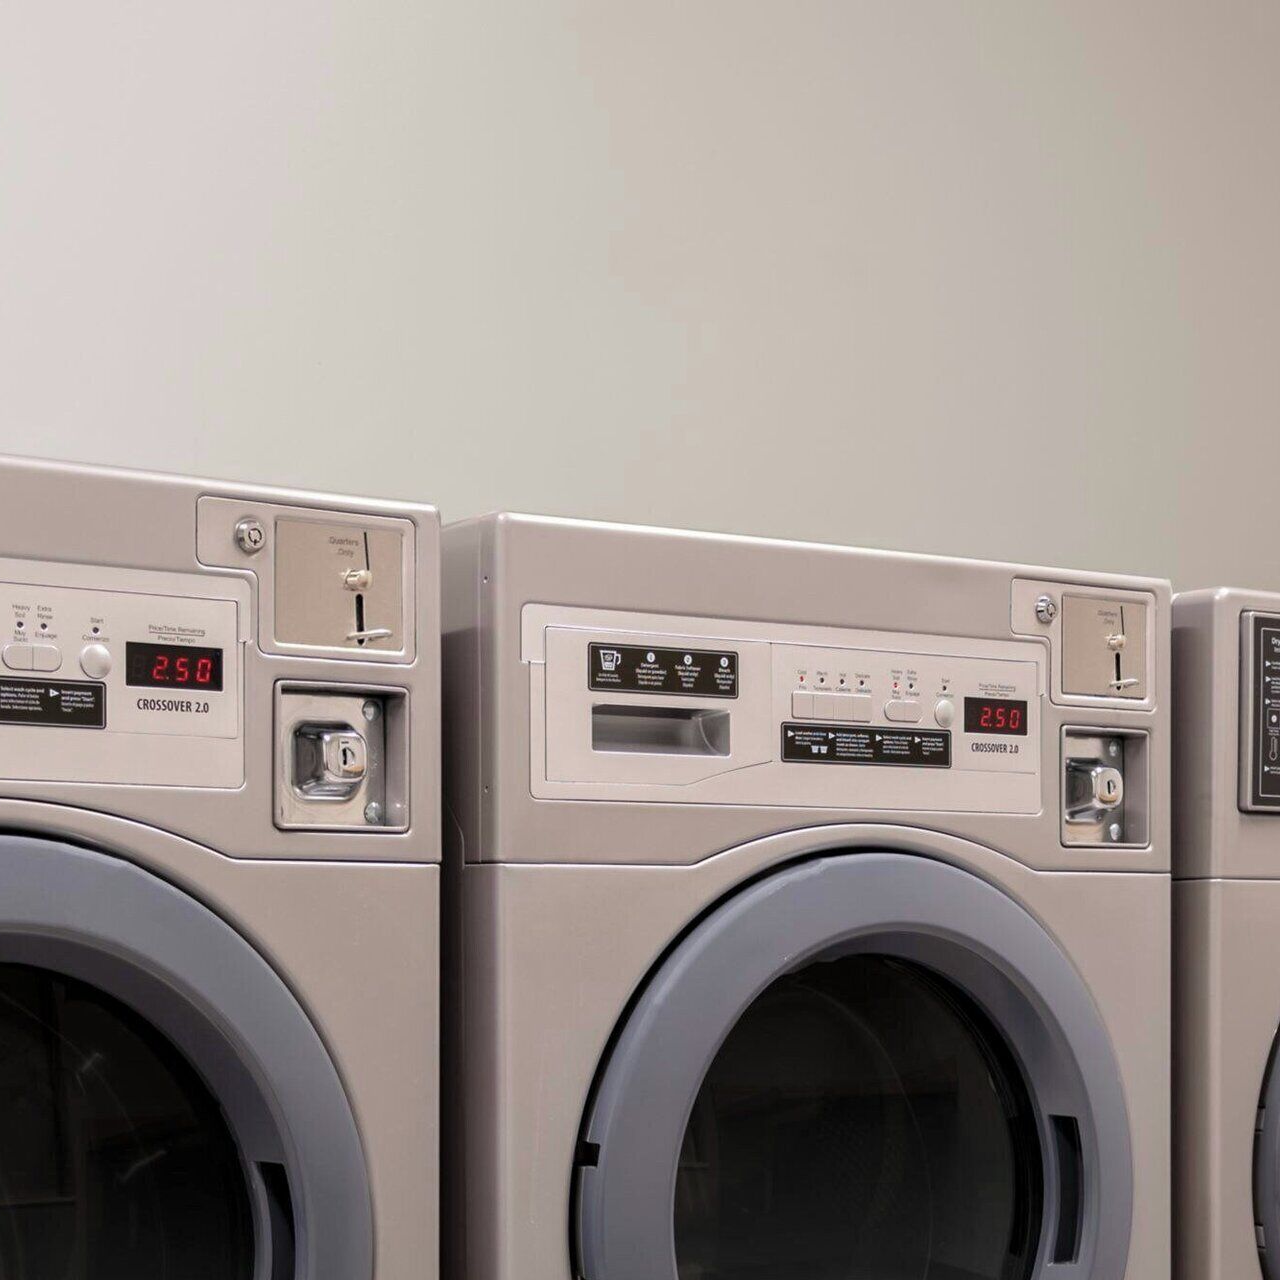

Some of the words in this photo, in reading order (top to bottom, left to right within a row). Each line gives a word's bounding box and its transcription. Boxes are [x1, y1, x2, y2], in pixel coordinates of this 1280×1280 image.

[330, 536, 358, 546] Quarters
[12, 604, 31, 612] Heavy
[152, 656, 212, 682] 2.50
[137, 698, 192, 712] CROSSOVER
[195, 702, 209, 713] 2.0
[980, 706, 1020, 729] 2.50
[971, 742, 1008, 754] CROSSOVER
[1009, 744, 1019, 754] 2.0
